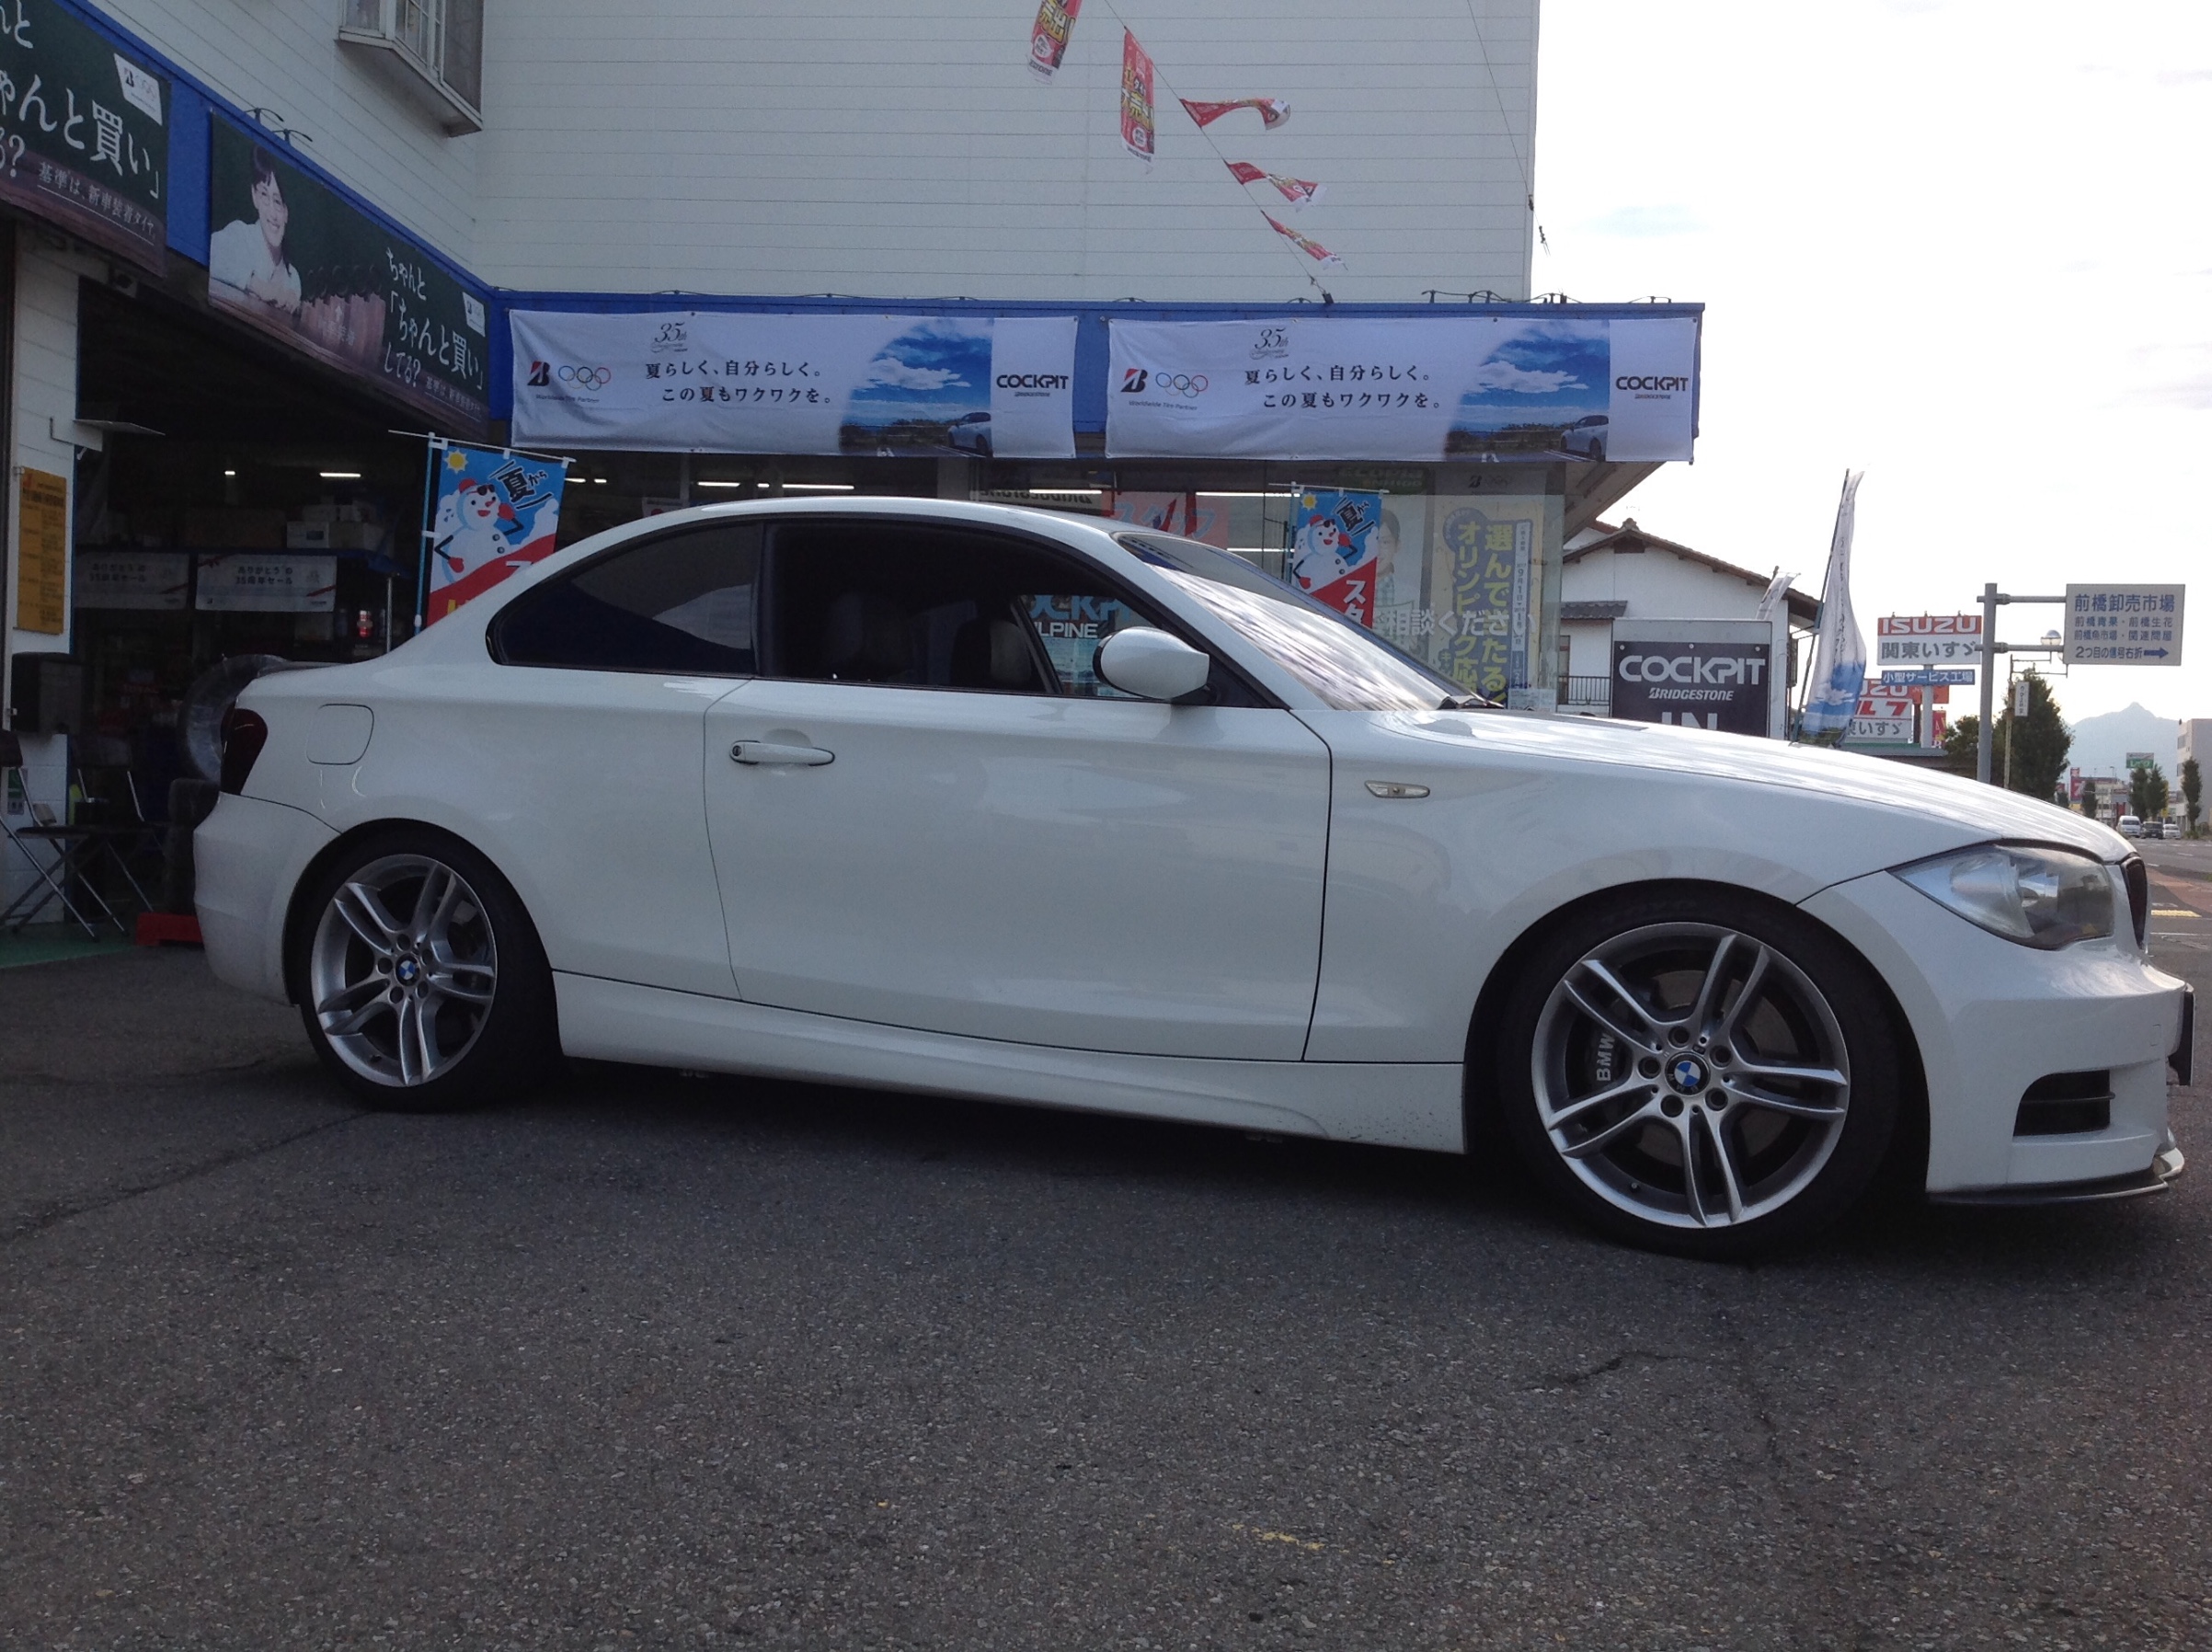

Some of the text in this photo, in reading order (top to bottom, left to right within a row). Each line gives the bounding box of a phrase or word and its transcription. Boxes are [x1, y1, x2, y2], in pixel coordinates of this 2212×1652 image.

[385, 247, 427, 301] ちゃんと
[646, 360, 821, 379] 夏らしく、自分らしく。
[1244, 365, 1430, 384] 夏らしく、自分らしく。
[996, 374, 1070, 390] COCKPIT
[1615, 375, 1689, 392] COCKPIT
[662, 385, 831, 405] この夏もワクワクを。
[1263, 392, 1440, 409] この夏もワクワクを。
[2074, 594, 2175, 613] 前橋卸売市場
[1882, 617, 1977, 635] ISUZU
[1619, 655, 1766, 685] COCKPIT
[1883, 670, 1975, 683] 小型サービス工場
[1648, 687, 1735, 702] BRIDGESTONE
[1596, 1032, 1615, 1082] BMW
